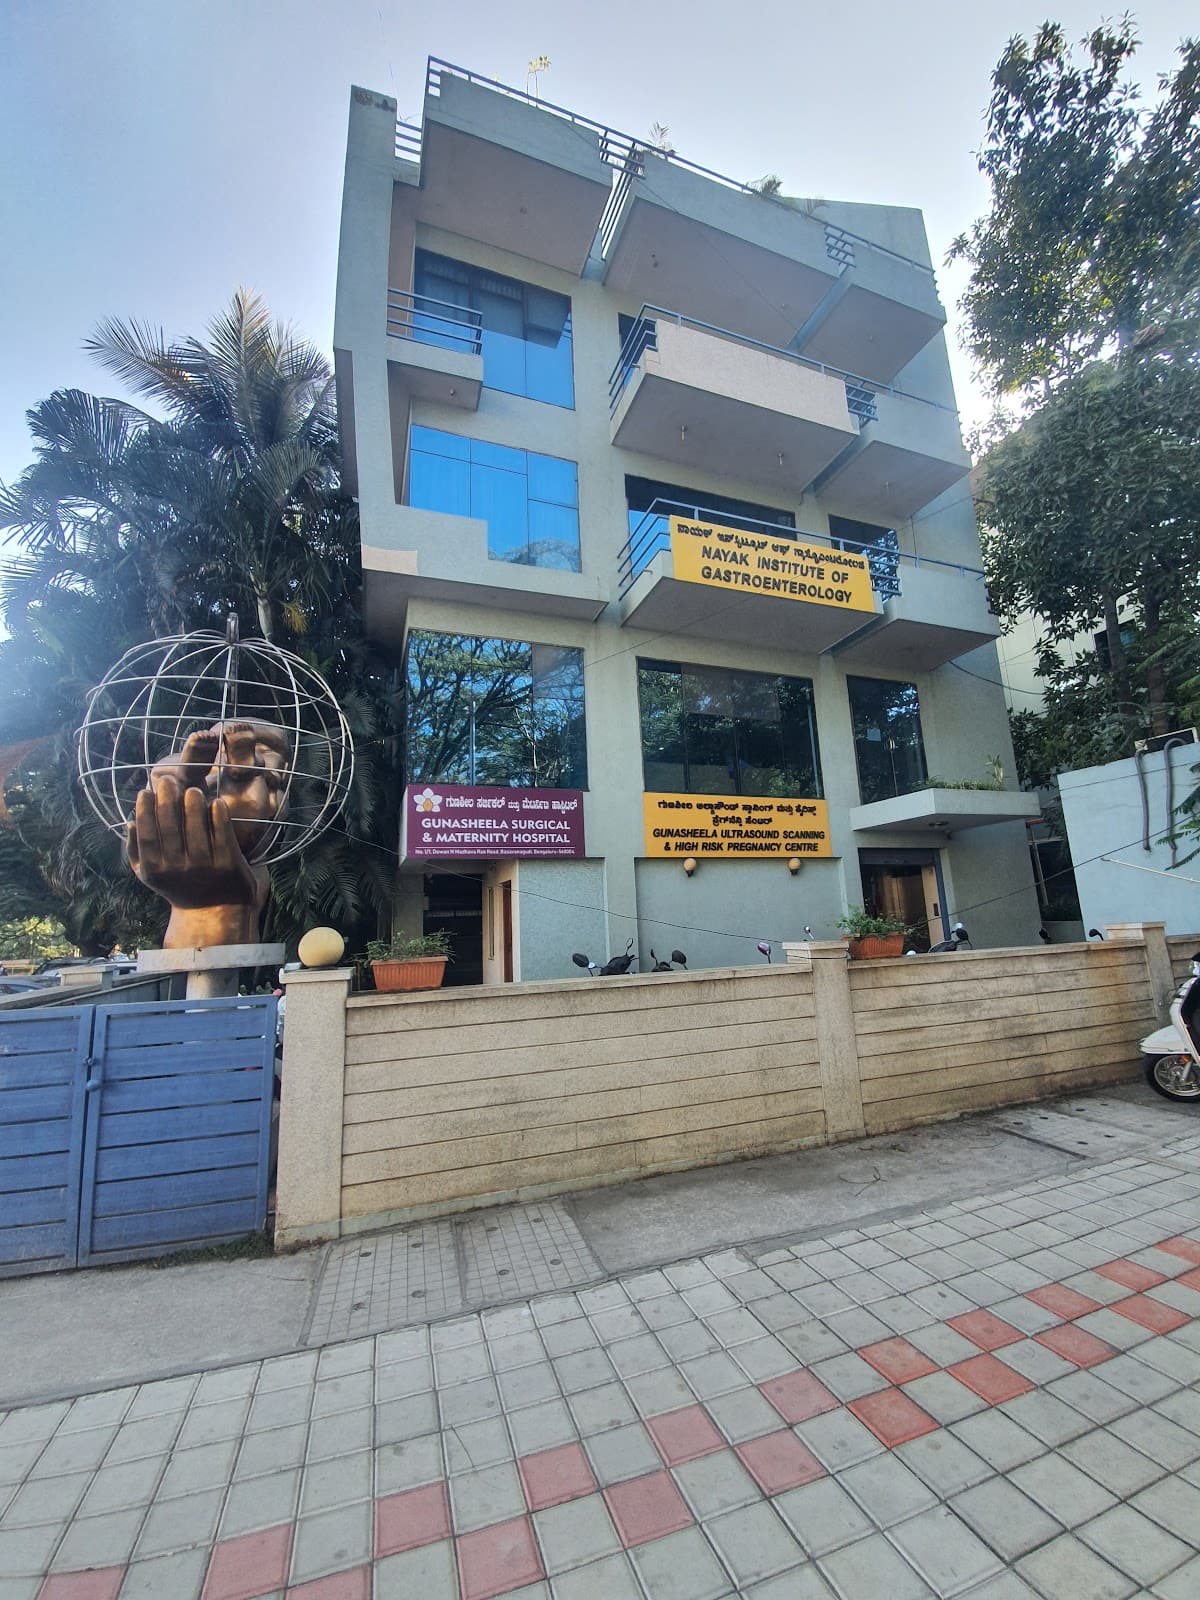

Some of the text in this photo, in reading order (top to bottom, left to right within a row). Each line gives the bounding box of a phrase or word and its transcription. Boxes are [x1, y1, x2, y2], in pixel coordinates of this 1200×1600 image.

[701, 545, 849, 584] NAYAK INSTITUTE OF
[701, 565, 852, 604] GASTROENTEROLOGY
[421, 818, 571, 831] GUNASHEELA SURGICAL
[422, 832, 571, 843] & MATERNITY HOSPITAL
[652, 828, 826, 840] GUNASHEELA ULTRASOUND SCANNING
[663, 841, 819, 852] & HIGH RISK PREGNANCY CENTRE
